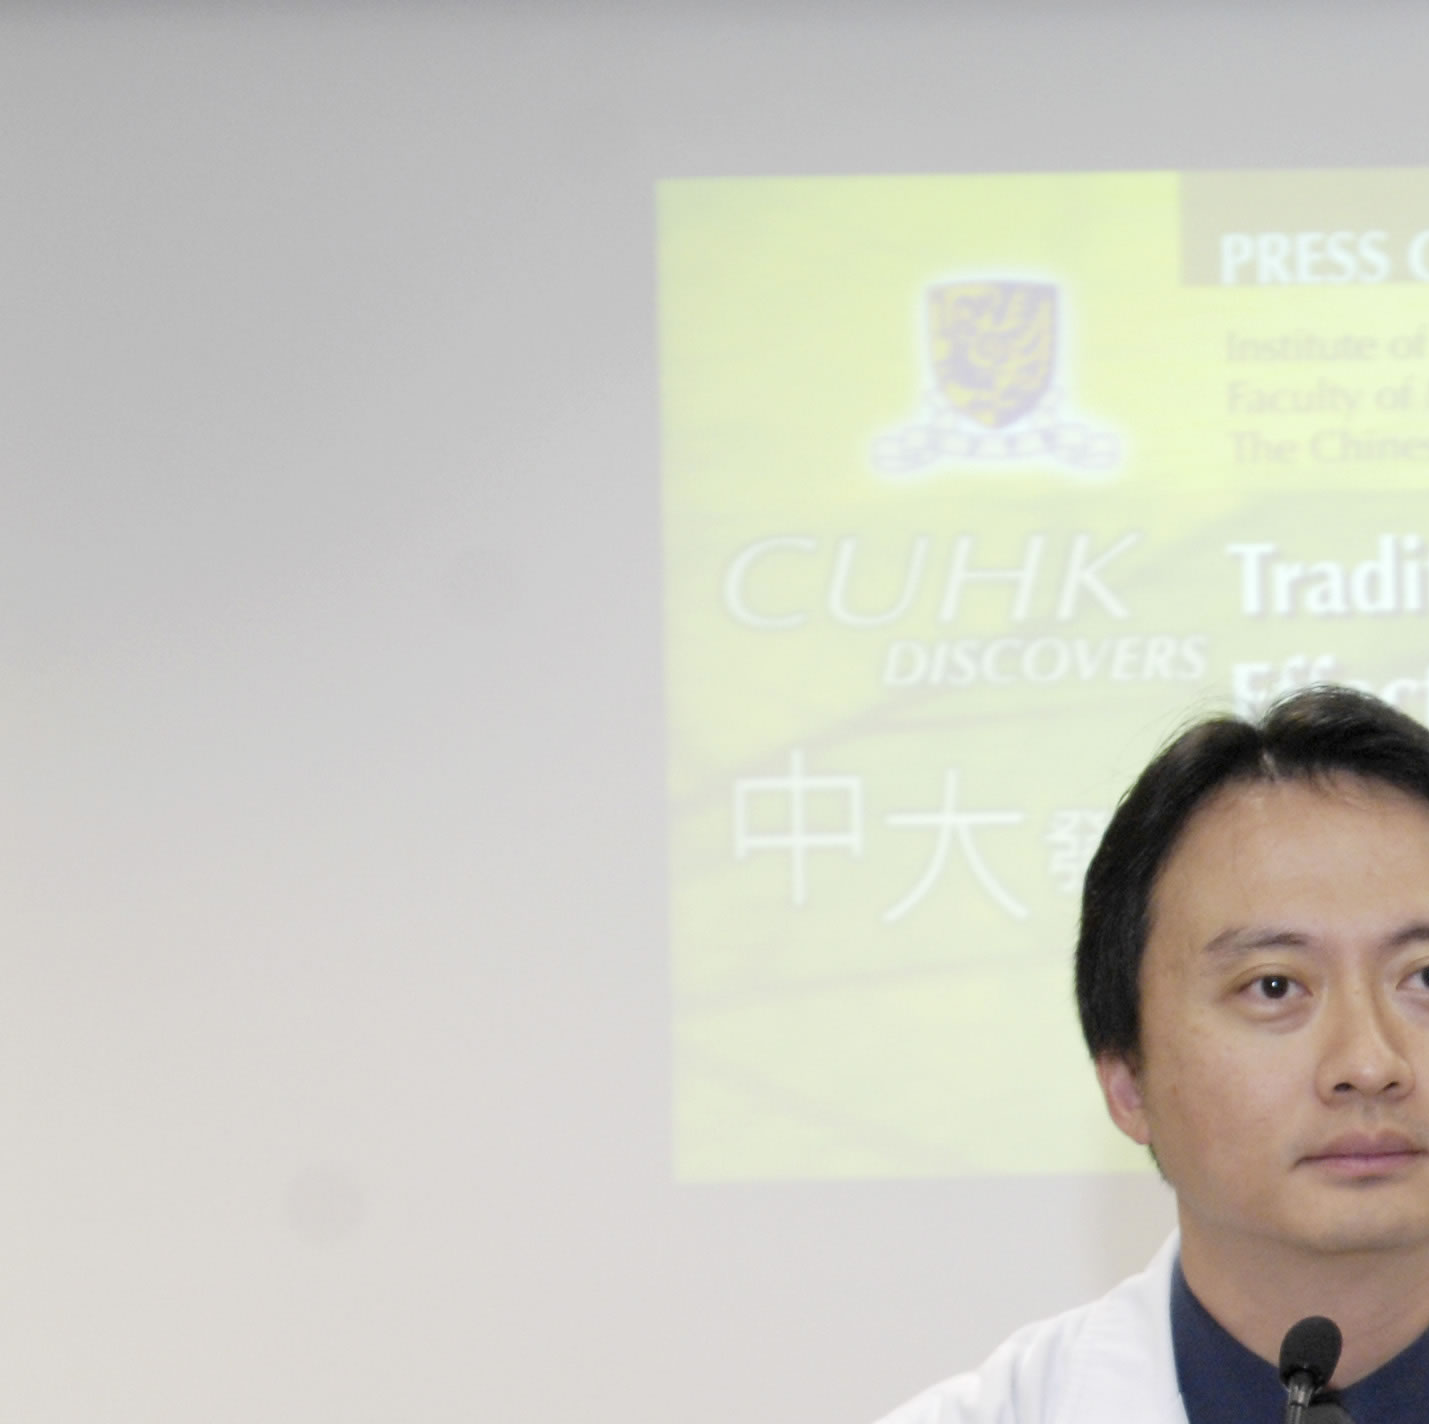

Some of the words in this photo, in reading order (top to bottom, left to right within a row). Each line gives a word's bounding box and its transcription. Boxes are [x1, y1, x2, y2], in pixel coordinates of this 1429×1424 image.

[1220, 230, 1391, 285] PRESS
[1225, 329, 1378, 363] Institute
[1388, 325, 1429, 360] of
[1226, 377, 1360, 420] Faculty
[1374, 375, 1416, 413] of
[1228, 428, 1298, 465] The
[722, 530, 1145, 629] CUHK
[883, 632, 1211, 688] DISCOVERS
